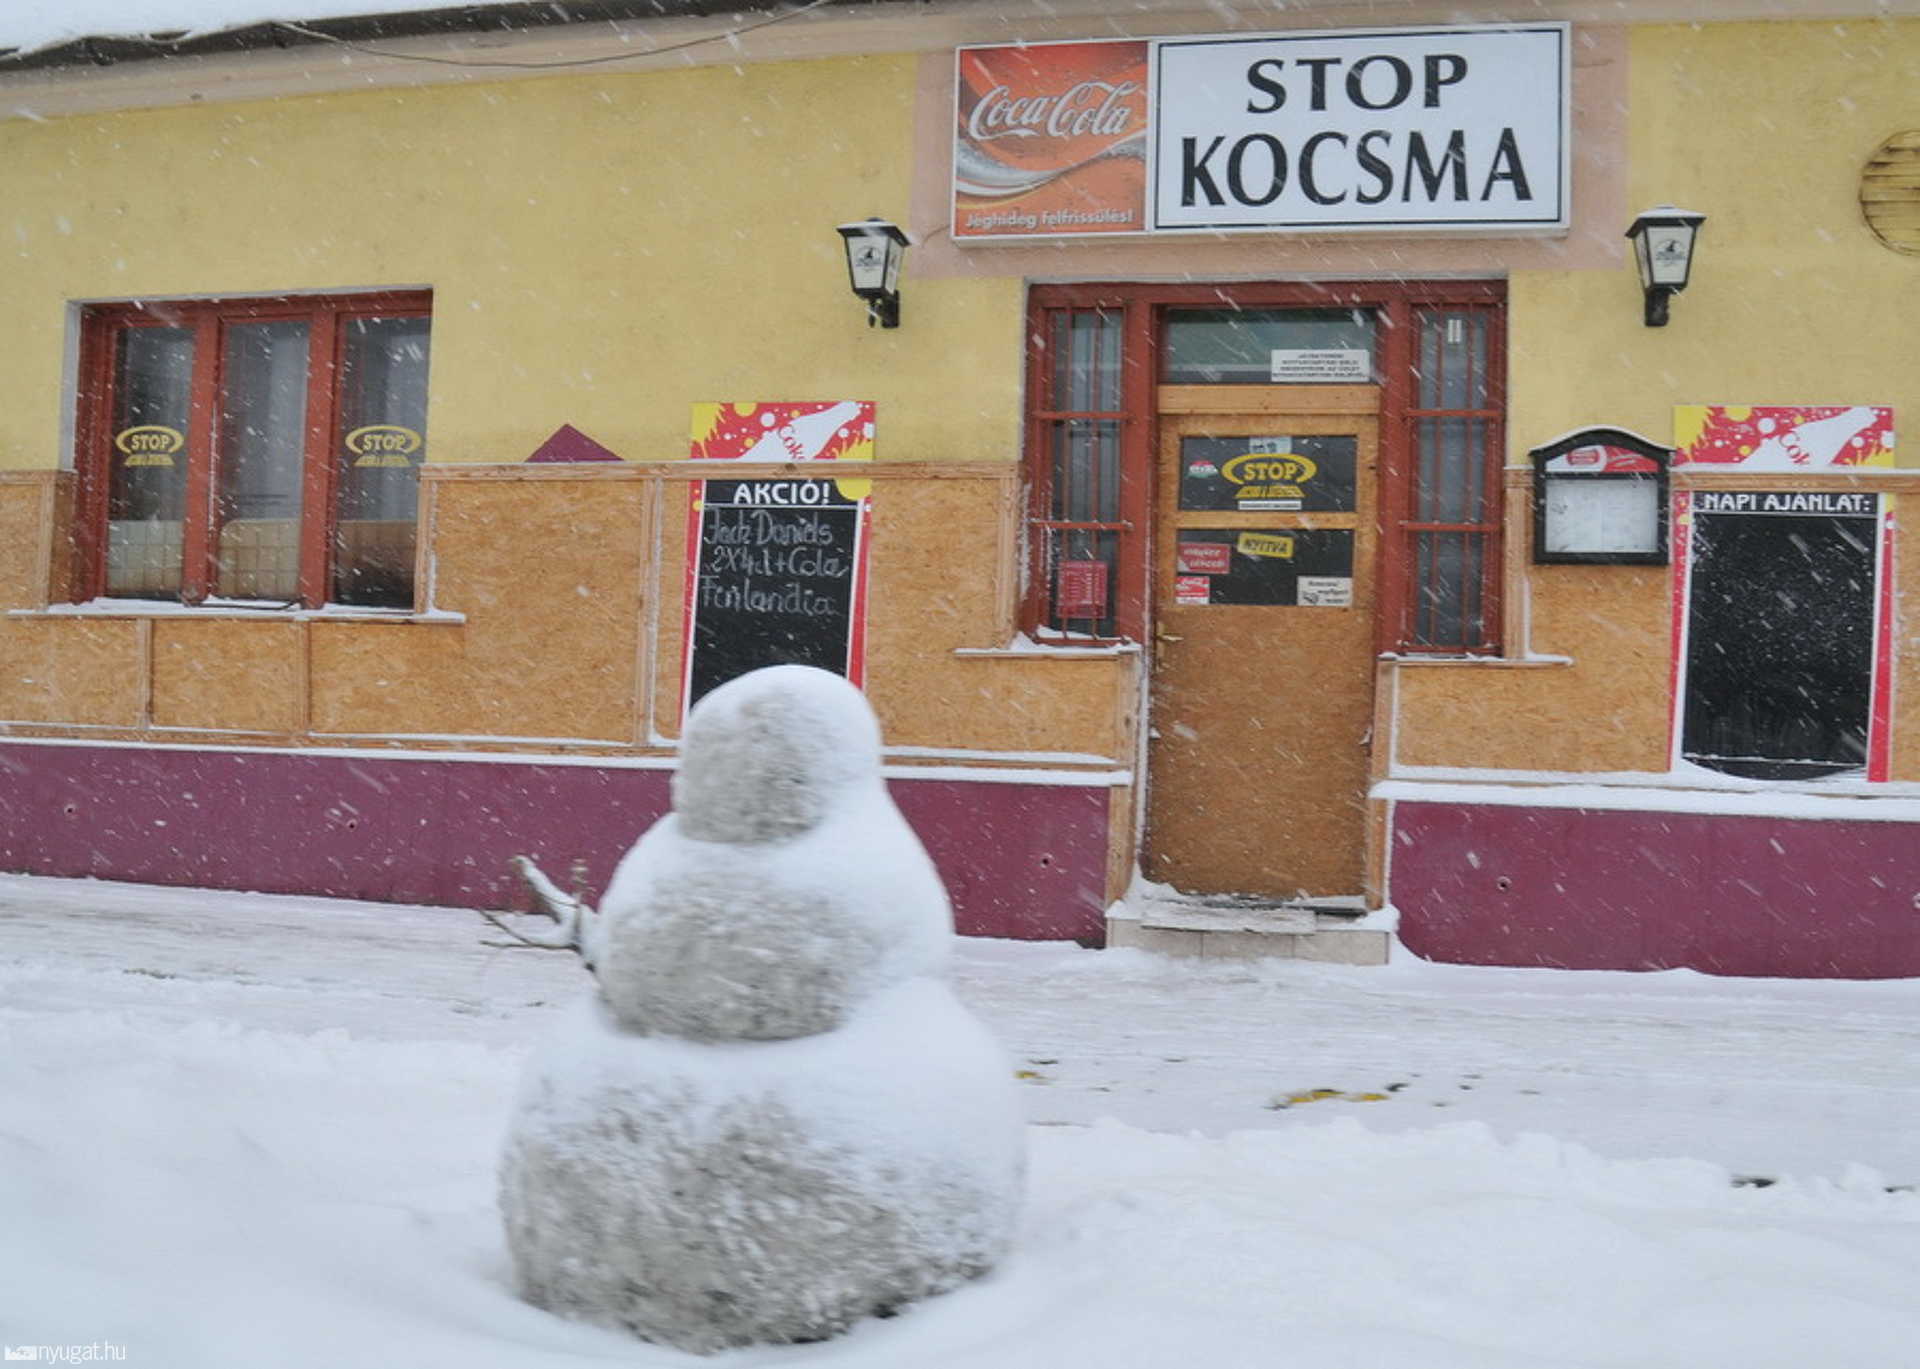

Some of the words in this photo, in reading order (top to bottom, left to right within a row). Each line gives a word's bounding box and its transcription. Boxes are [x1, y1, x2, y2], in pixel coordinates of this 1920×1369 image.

[1246, 54, 1468, 114] STOP
[968, 81, 1140, 141] Coca-Cola
[1180, 127, 1533, 207] KOCSMA
[131, 434, 169, 450] STOP
[363, 434, 406, 451] STOP
[1243, 462, 1297, 481] STOP
[1703, 493, 1757, 511] NAPI
[700, 575, 842, 616] Finlandia
